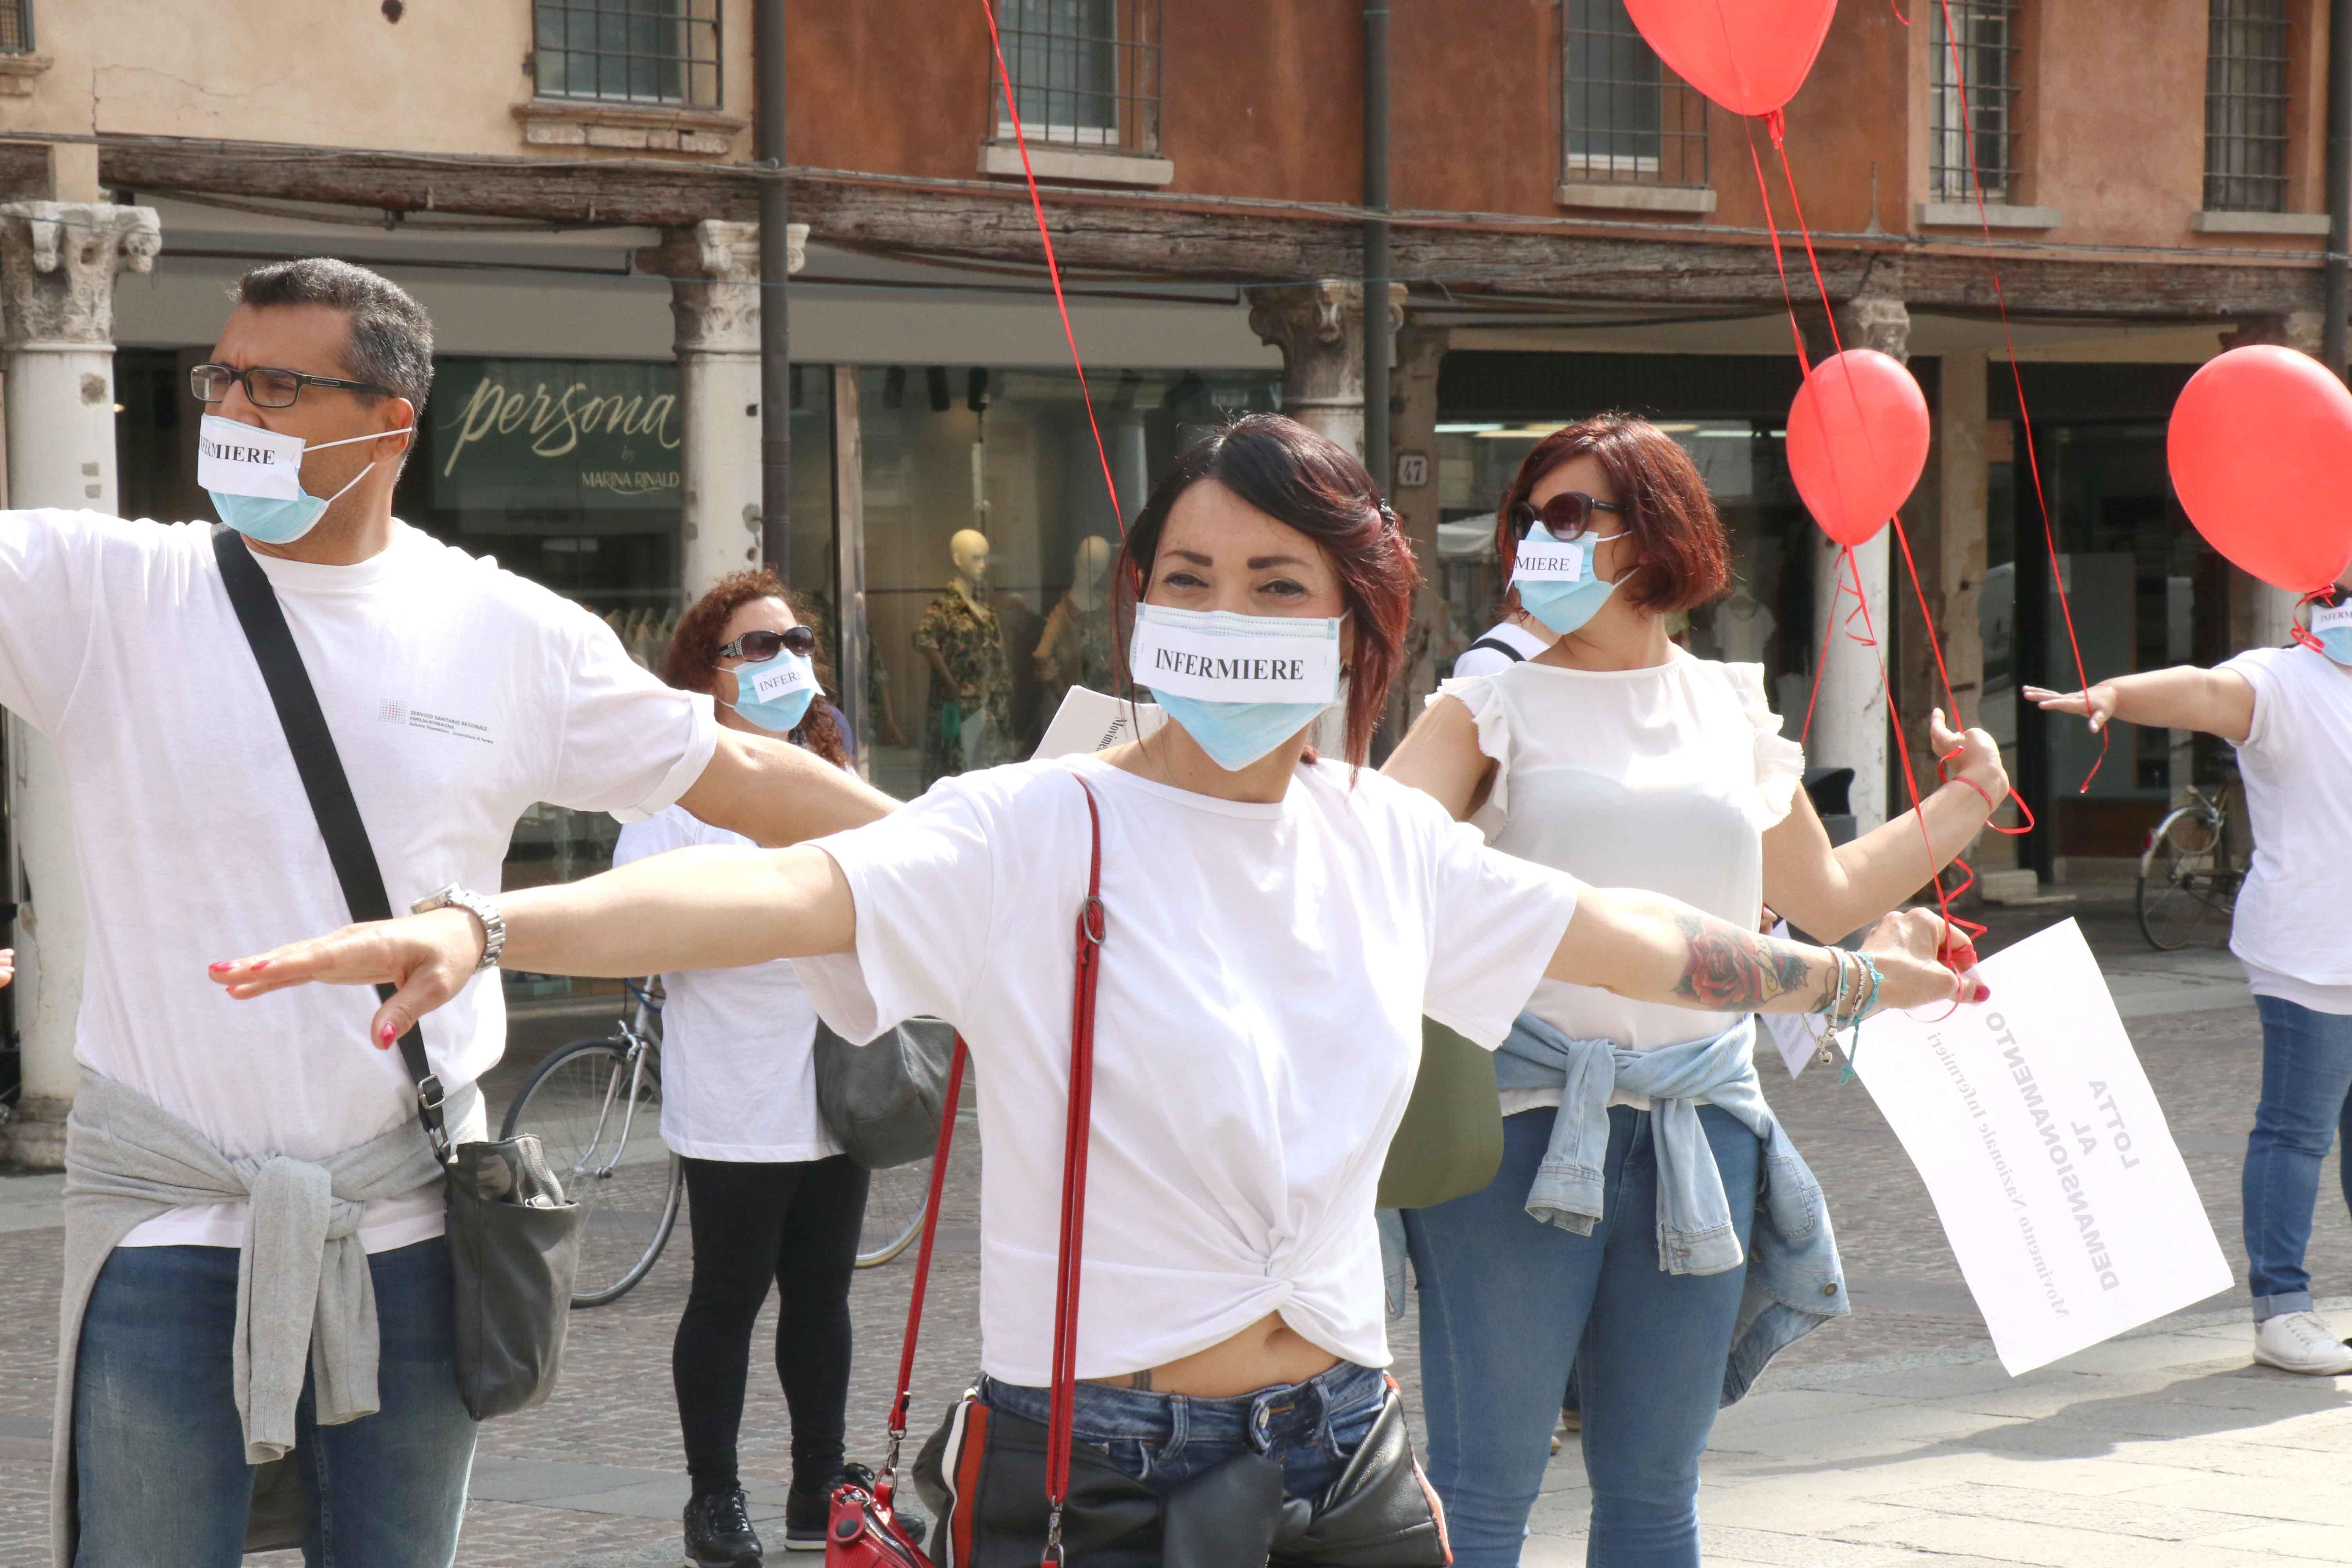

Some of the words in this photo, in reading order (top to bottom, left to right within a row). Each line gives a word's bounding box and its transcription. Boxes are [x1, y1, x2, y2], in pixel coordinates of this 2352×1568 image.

[438, 377, 680, 477] persona
[622, 445, 634, 464] by
[582, 471, 631, 487] MARINA
[1514, 556, 1569, 571] MIERE
[1156, 648, 1304, 680] INFERMIERE
[410, 710, 433, 719] SERVIZIO
[435, 715, 459, 725] SANITARIO
[461, 721, 487, 731] REGIONALE
[410, 716, 454, 729] EMILIA-ROMAGNA
